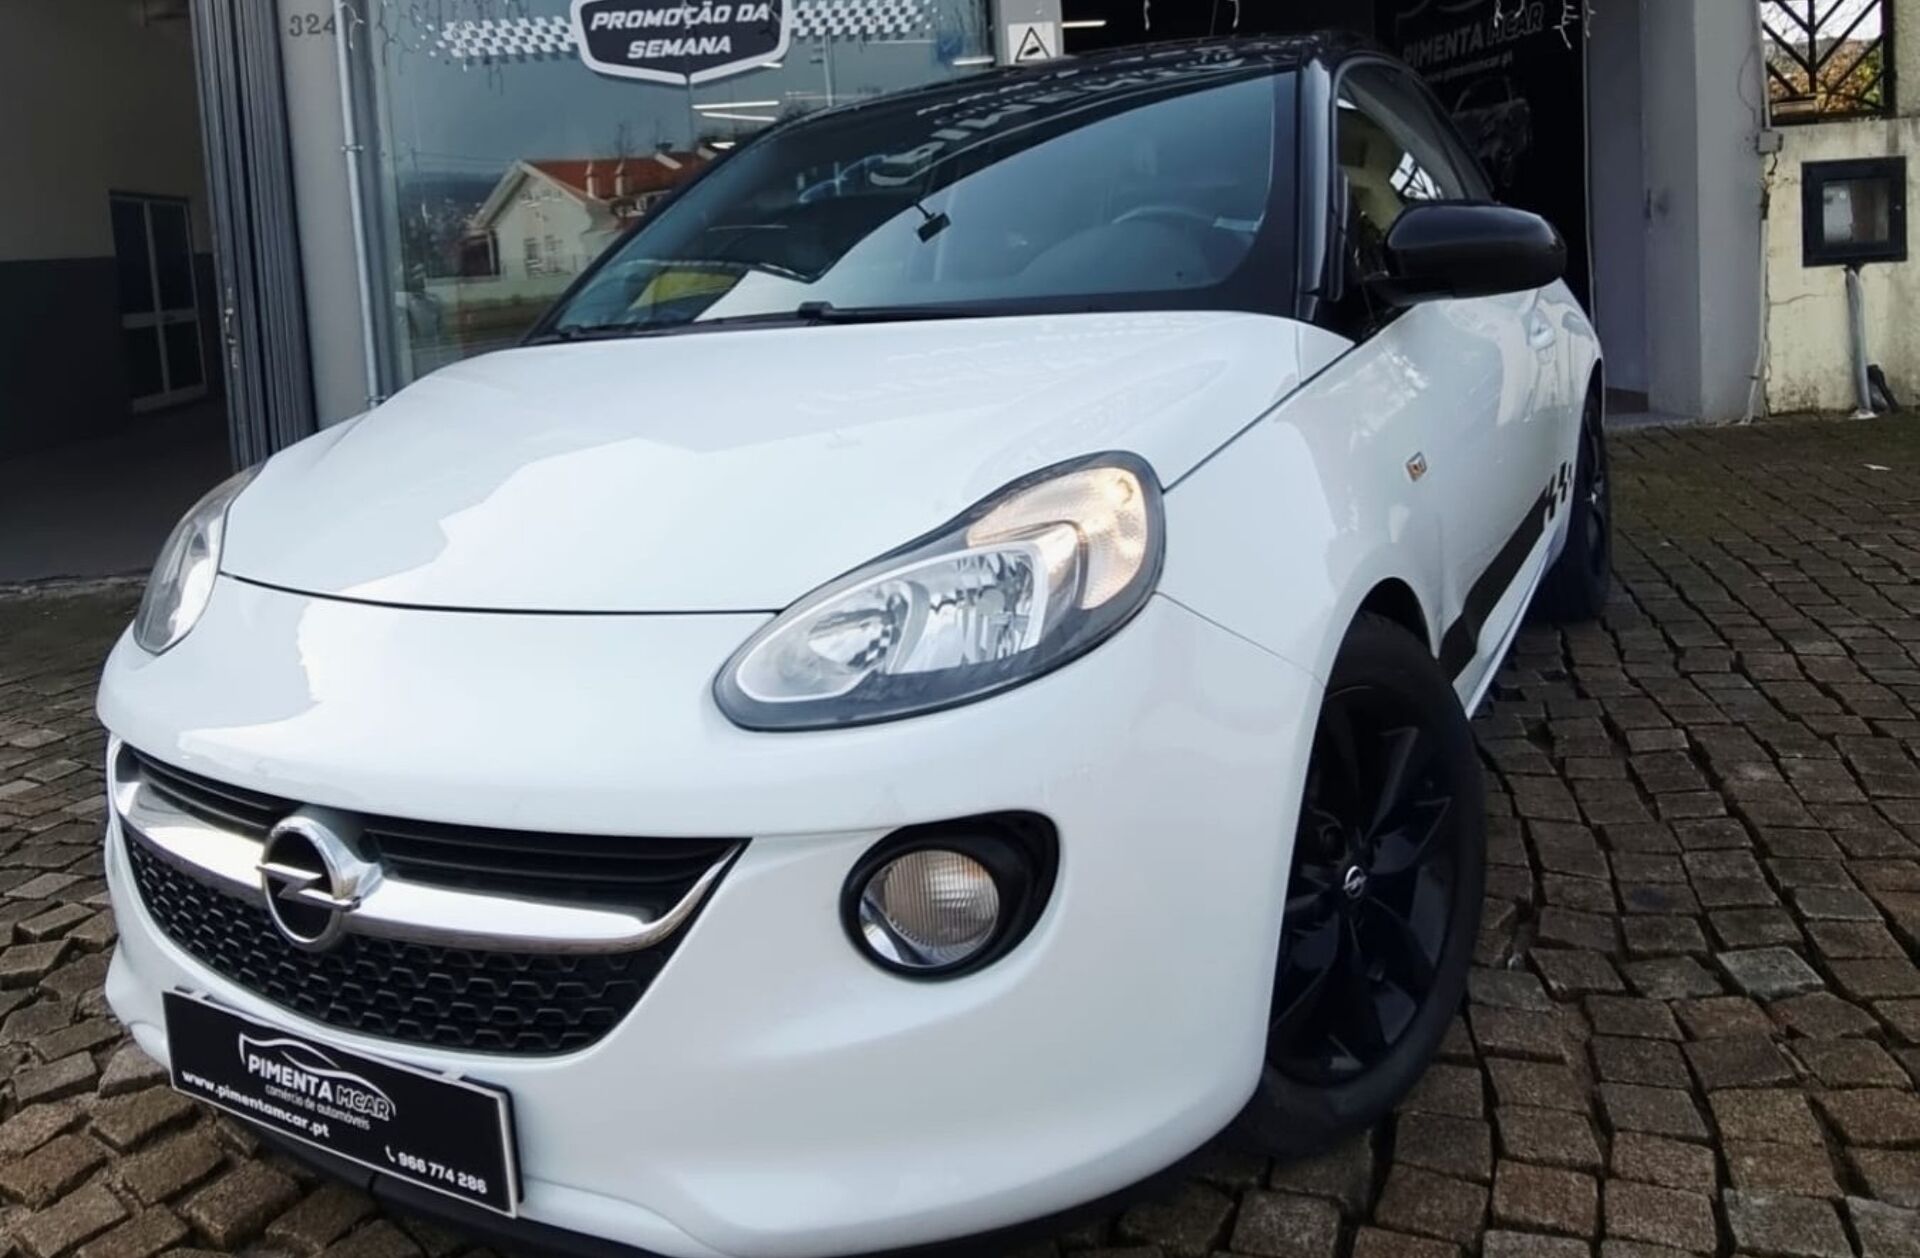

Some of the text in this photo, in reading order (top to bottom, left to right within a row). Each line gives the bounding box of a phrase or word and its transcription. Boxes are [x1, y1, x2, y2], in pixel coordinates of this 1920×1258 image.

[289, 13, 336, 37] 324
[590, 1, 770, 30] PROMOÇÃO DA
[627, 36, 731, 59] SEMANA
[1402, 21, 1485, 68] PIMENTA
[248, 1053, 390, 1122] PIMENTA MCAR
[182, 1070, 330, 1138] www.pimentamcar.pt
[428, 1161, 455, 1184] 774
